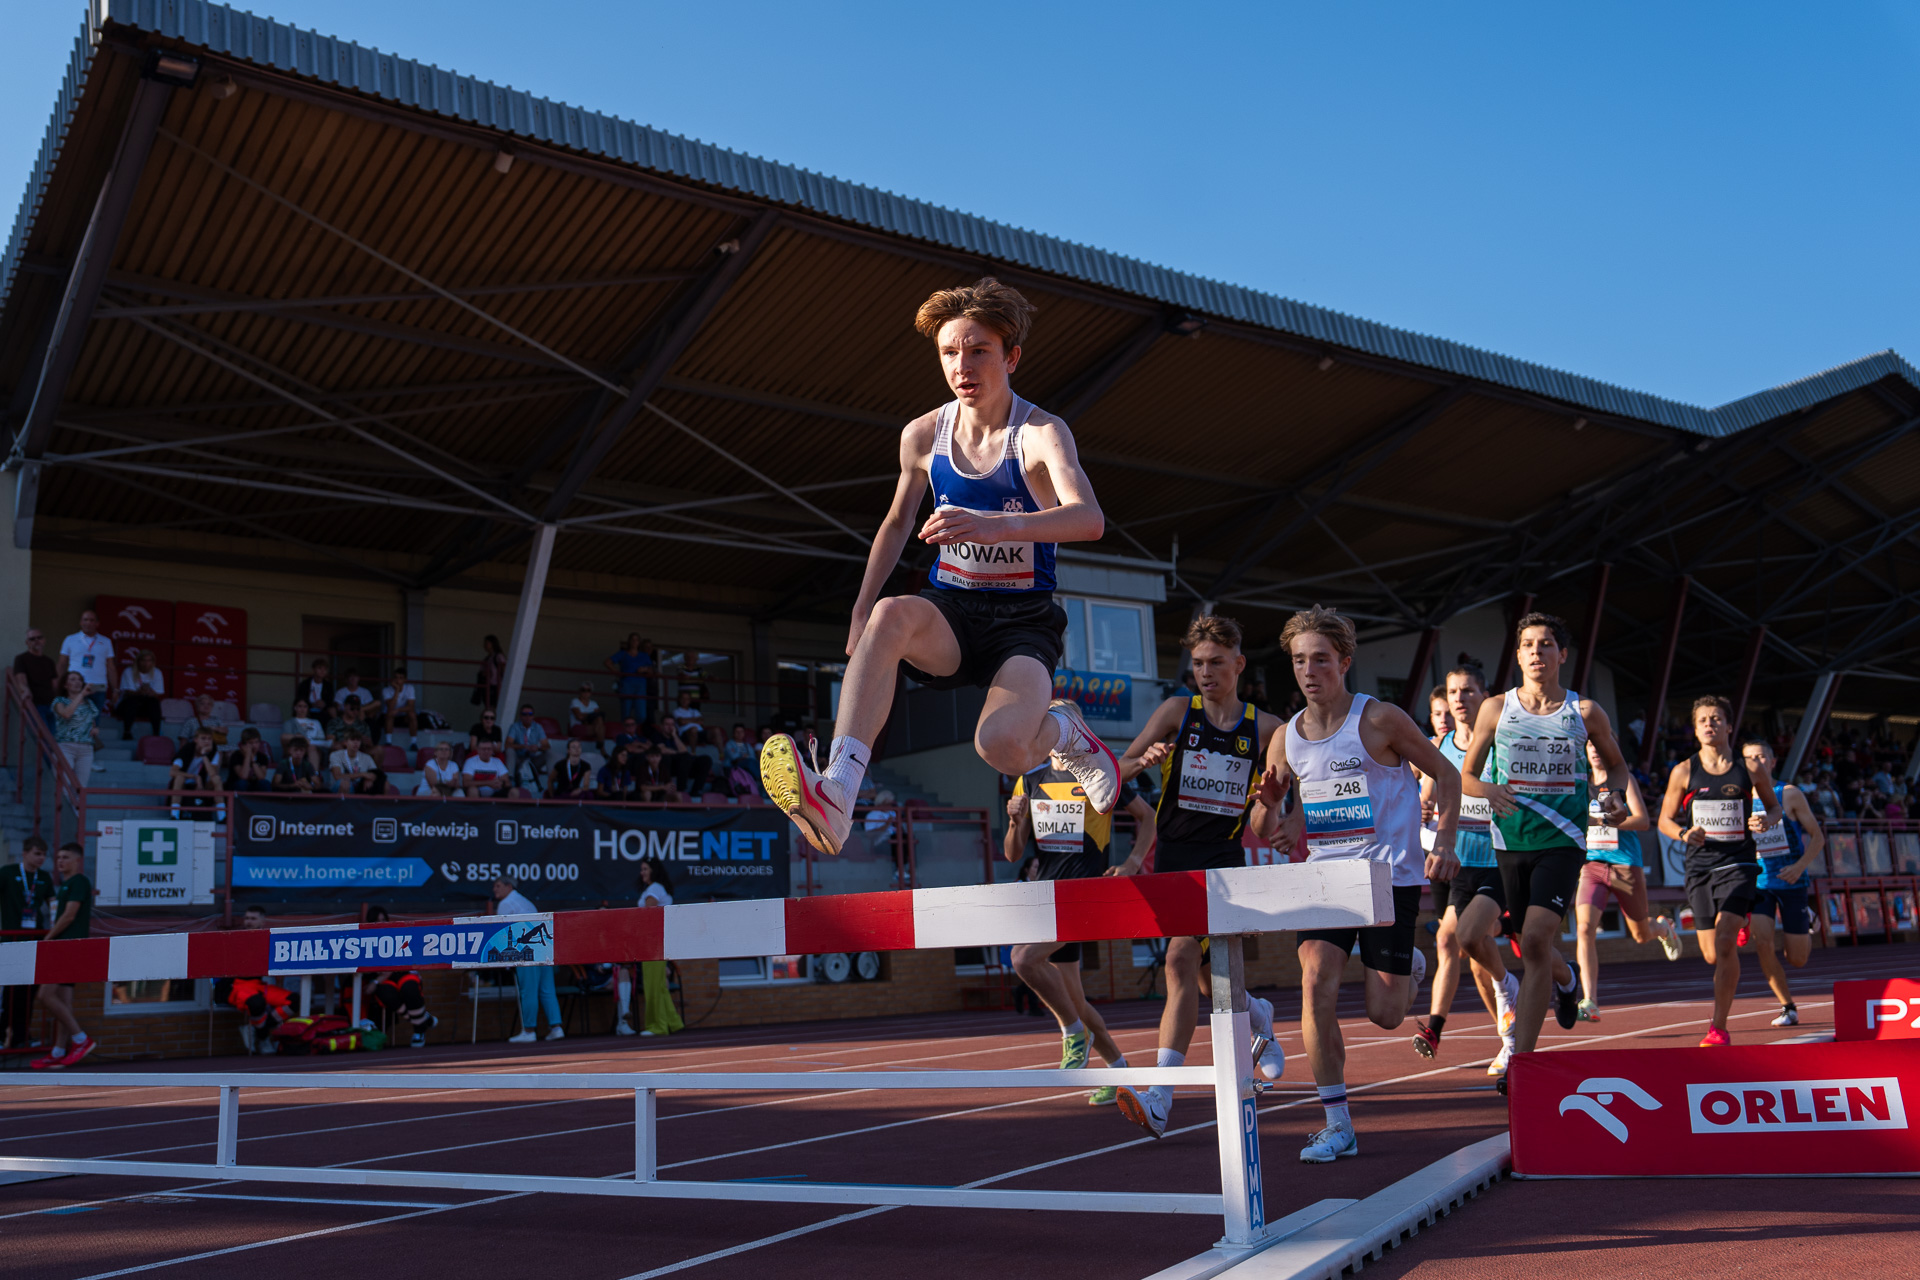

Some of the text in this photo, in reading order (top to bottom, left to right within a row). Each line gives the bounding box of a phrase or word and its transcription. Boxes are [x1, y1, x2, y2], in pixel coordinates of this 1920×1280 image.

[947, 543, 1024, 563] NOWAK
[952, 575, 994, 588] BIAŁYSTOK
[1547, 743, 1571, 754] 324
[1226, 760, 1241, 772] 79
[1510, 761, 1573, 775] CHRAPEK
[1182, 775, 1245, 796] KŁOPOTEK
[1334, 781, 1361, 796] 248
[1056, 803, 1083, 814] 1052
[1188, 803, 1219, 812] BIAŁYSTOK
[1460, 804, 1492, 815] YMSKI
[1720, 802, 1739, 811] 288
[1307, 803, 1371, 825] ADAMCZEWSKI
[1037, 821, 1076, 834] SIMLAT
[1695, 816, 1742, 826] KRAWCZYK
[279, 820, 354, 837] Internet
[400, 821, 479, 841] Telewizja
[521, 824, 579, 839] Telefon
[594, 829, 778, 861] HOMENET
[1319, 838, 1348, 846] BIAŁYSTOK
[1244, 847, 1290, 866] LEN
[249, 864, 414, 883] www.home-net.pl
[466, 863, 579, 881] 855 000 000
[687, 865, 773, 876] TECHNOLOGIES
[139, 872, 175, 883] PUNKT
[127, 887, 186, 898] MEDYCZNY
[274, 931, 485, 963] BIAŁYSTOK 2017
[1700, 1086, 1891, 1126] ORLEN
[1244, 1104, 1261, 1225] DIMA
